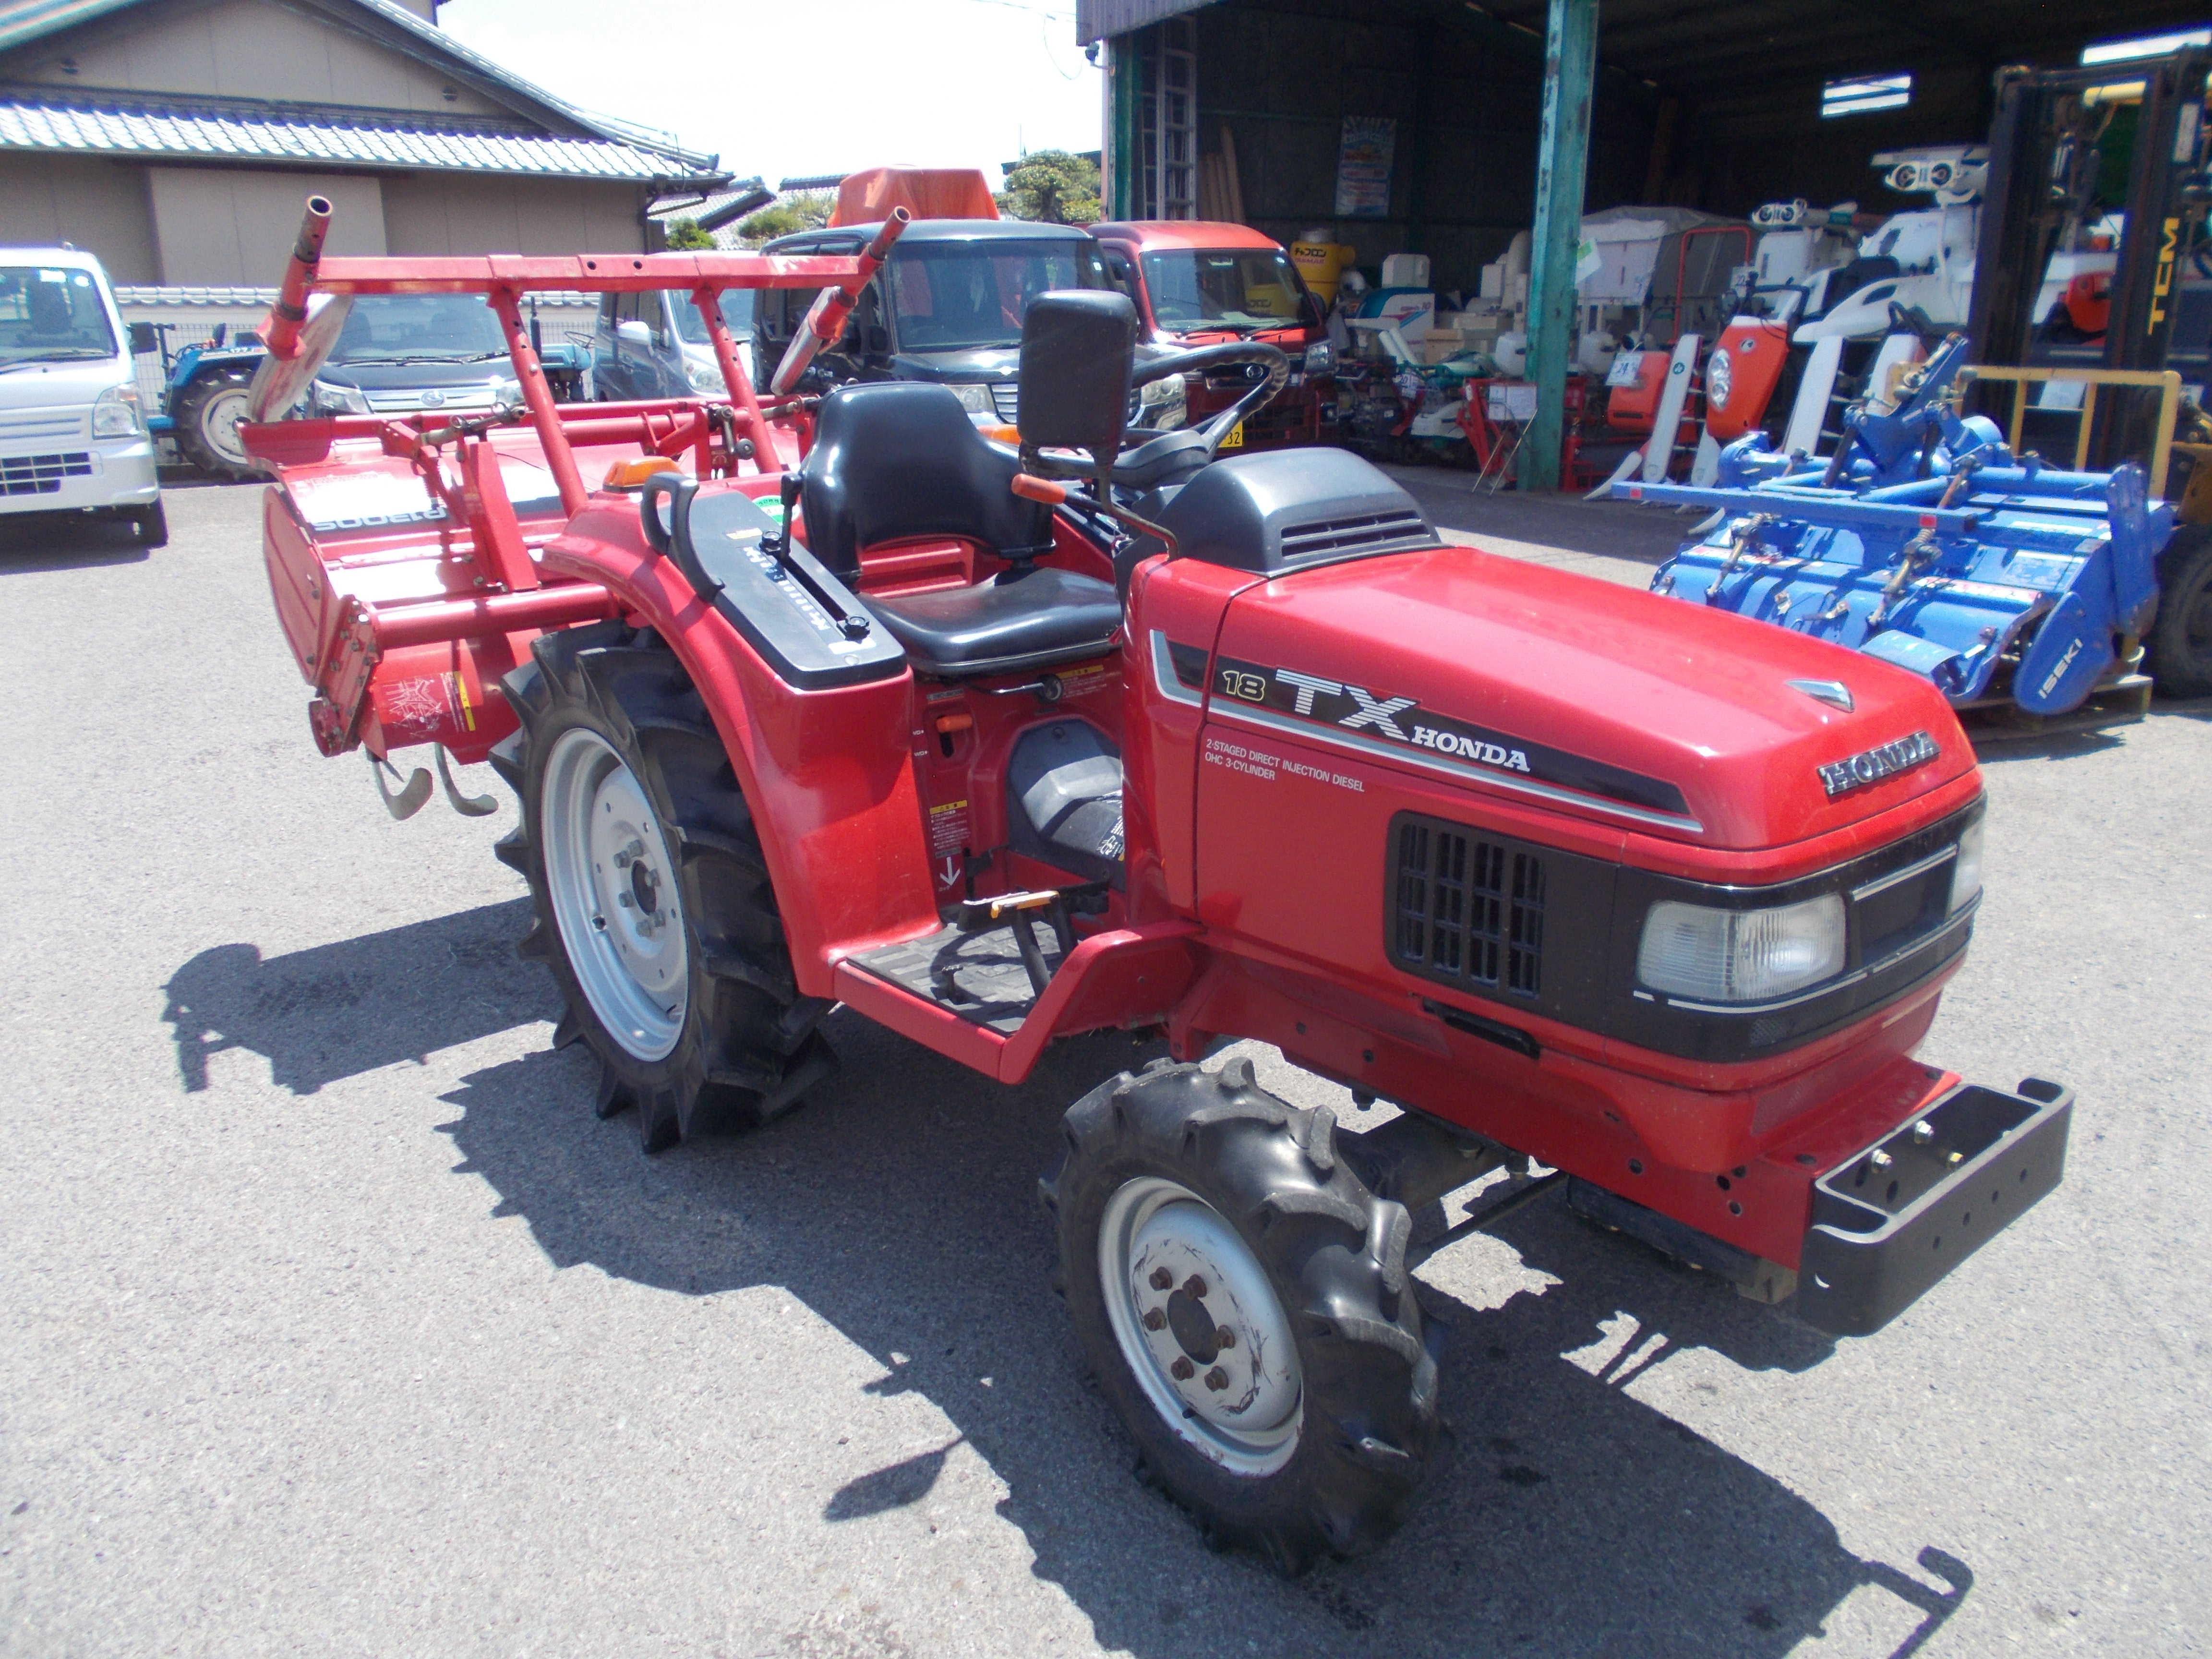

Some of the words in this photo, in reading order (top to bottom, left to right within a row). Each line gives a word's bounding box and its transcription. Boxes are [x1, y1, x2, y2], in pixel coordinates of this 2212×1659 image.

[2147, 217, 2180, 335] TCM
[2038, 638, 2083, 699] ISEKI
[1223, 671, 1266, 702] 18
[1275, 669, 1418, 742] TX
[1412, 725, 1531, 772] HONDA
[1205, 751, 1223, 765] OHC
[1249, 750, 1280, 768] DIRECT
[1282, 759, 1330, 782] INJECTION
[1332, 773, 1365, 792] DIESEL
[1818, 731, 1939, 795] HONDA
